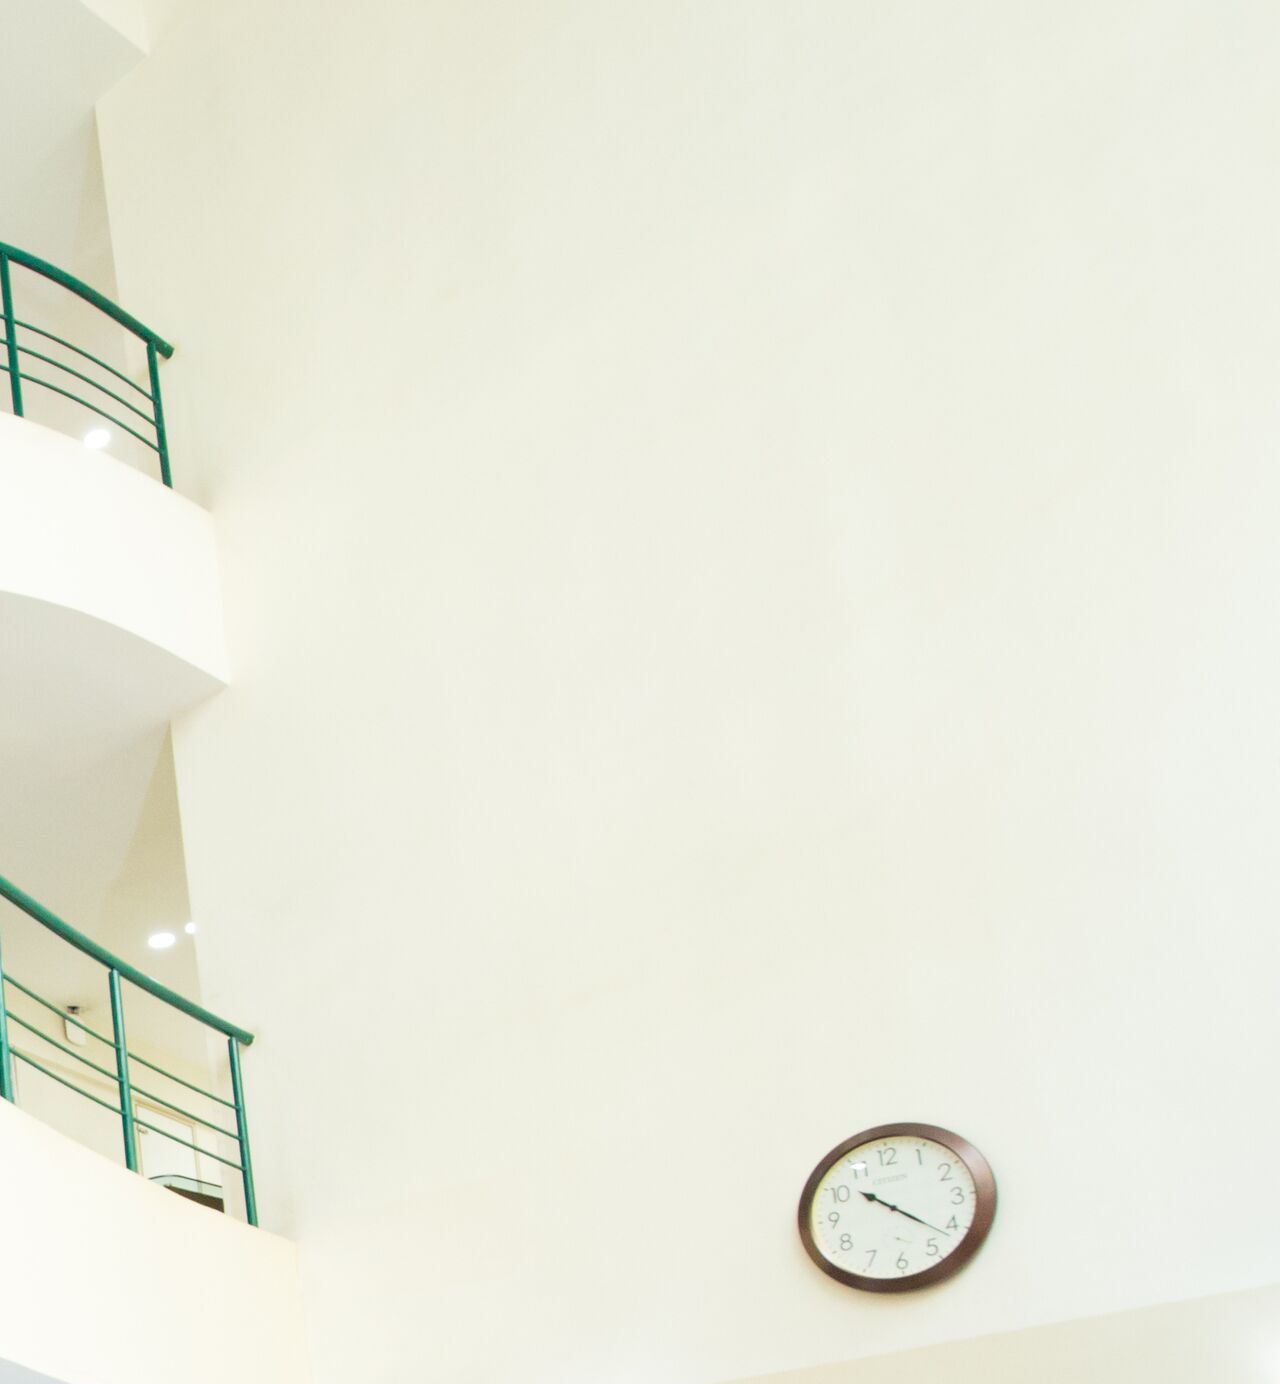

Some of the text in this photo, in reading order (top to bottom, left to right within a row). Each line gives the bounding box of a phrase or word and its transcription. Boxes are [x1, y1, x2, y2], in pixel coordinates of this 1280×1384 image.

[877, 1147, 898, 1166] 12
[915, 1148, 923, 1166] 1
[937, 1163, 952, 1182] 2
[830, 1185, 851, 1204] 10
[950, 1187, 965, 1205] 3
[827, 1211, 840, 1230] 9
[945, 1215, 960, 1231] 4
[839, 1233, 854, 1251] 8
[926, 1237, 939, 1257] 5
[865, 1249, 878, 1268] 7
[896, 1251, 909, 1270] 6
